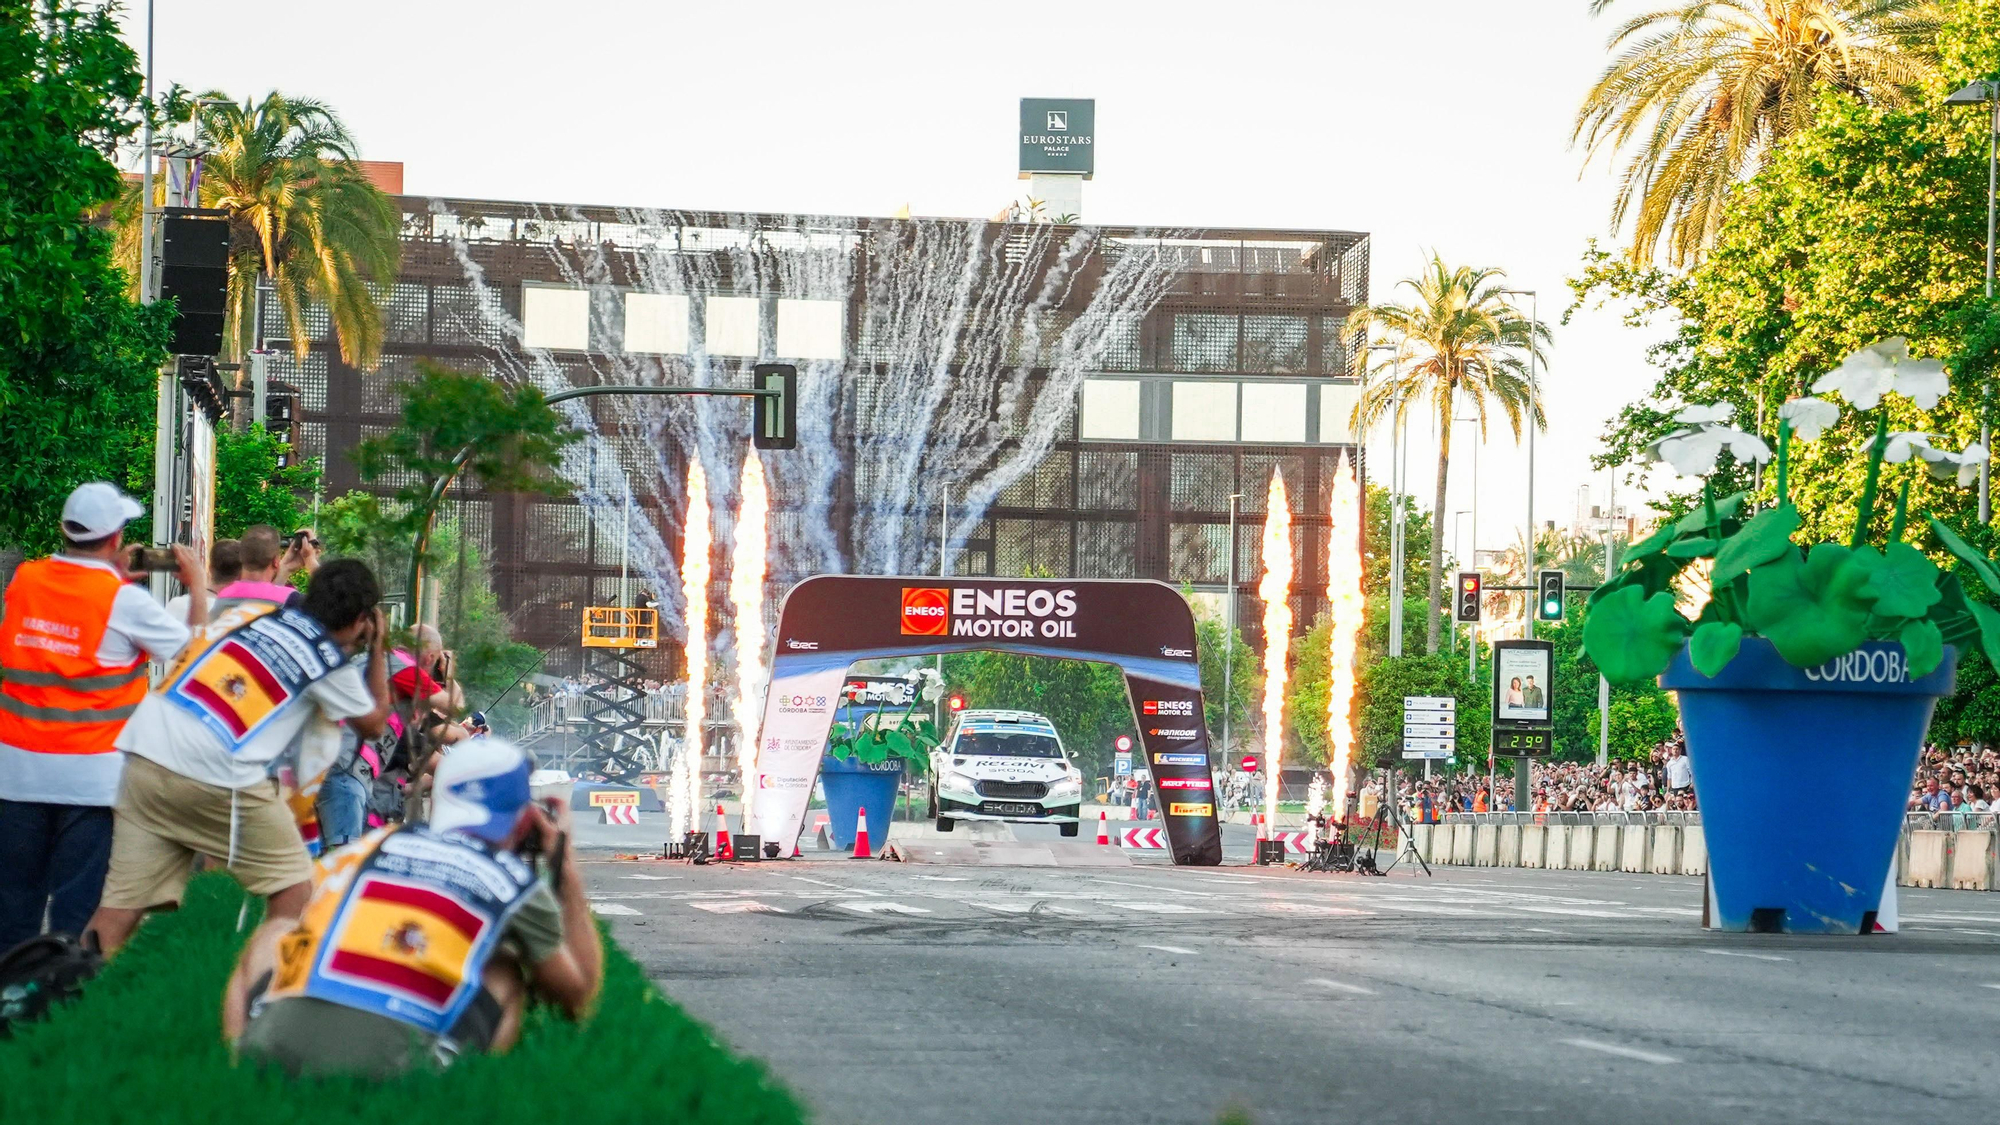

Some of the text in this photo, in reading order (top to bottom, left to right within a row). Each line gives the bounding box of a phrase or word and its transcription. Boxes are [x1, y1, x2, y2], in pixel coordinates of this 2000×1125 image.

[1023, 135, 1092, 145] EUROSTARS
[953, 588, 1077, 618] ENEOS
[905, 606, 945, 616] ENEOS
[952, 619, 1077, 638] MOTOR OIL
[633, 639, 656, 647] JCB
[1157, 700, 1193, 710] ENEOS
[975, 760, 1046, 769] Recalvi
[1118, 760, 1129, 774] P
[594, 794, 635, 804] PIRELLI
